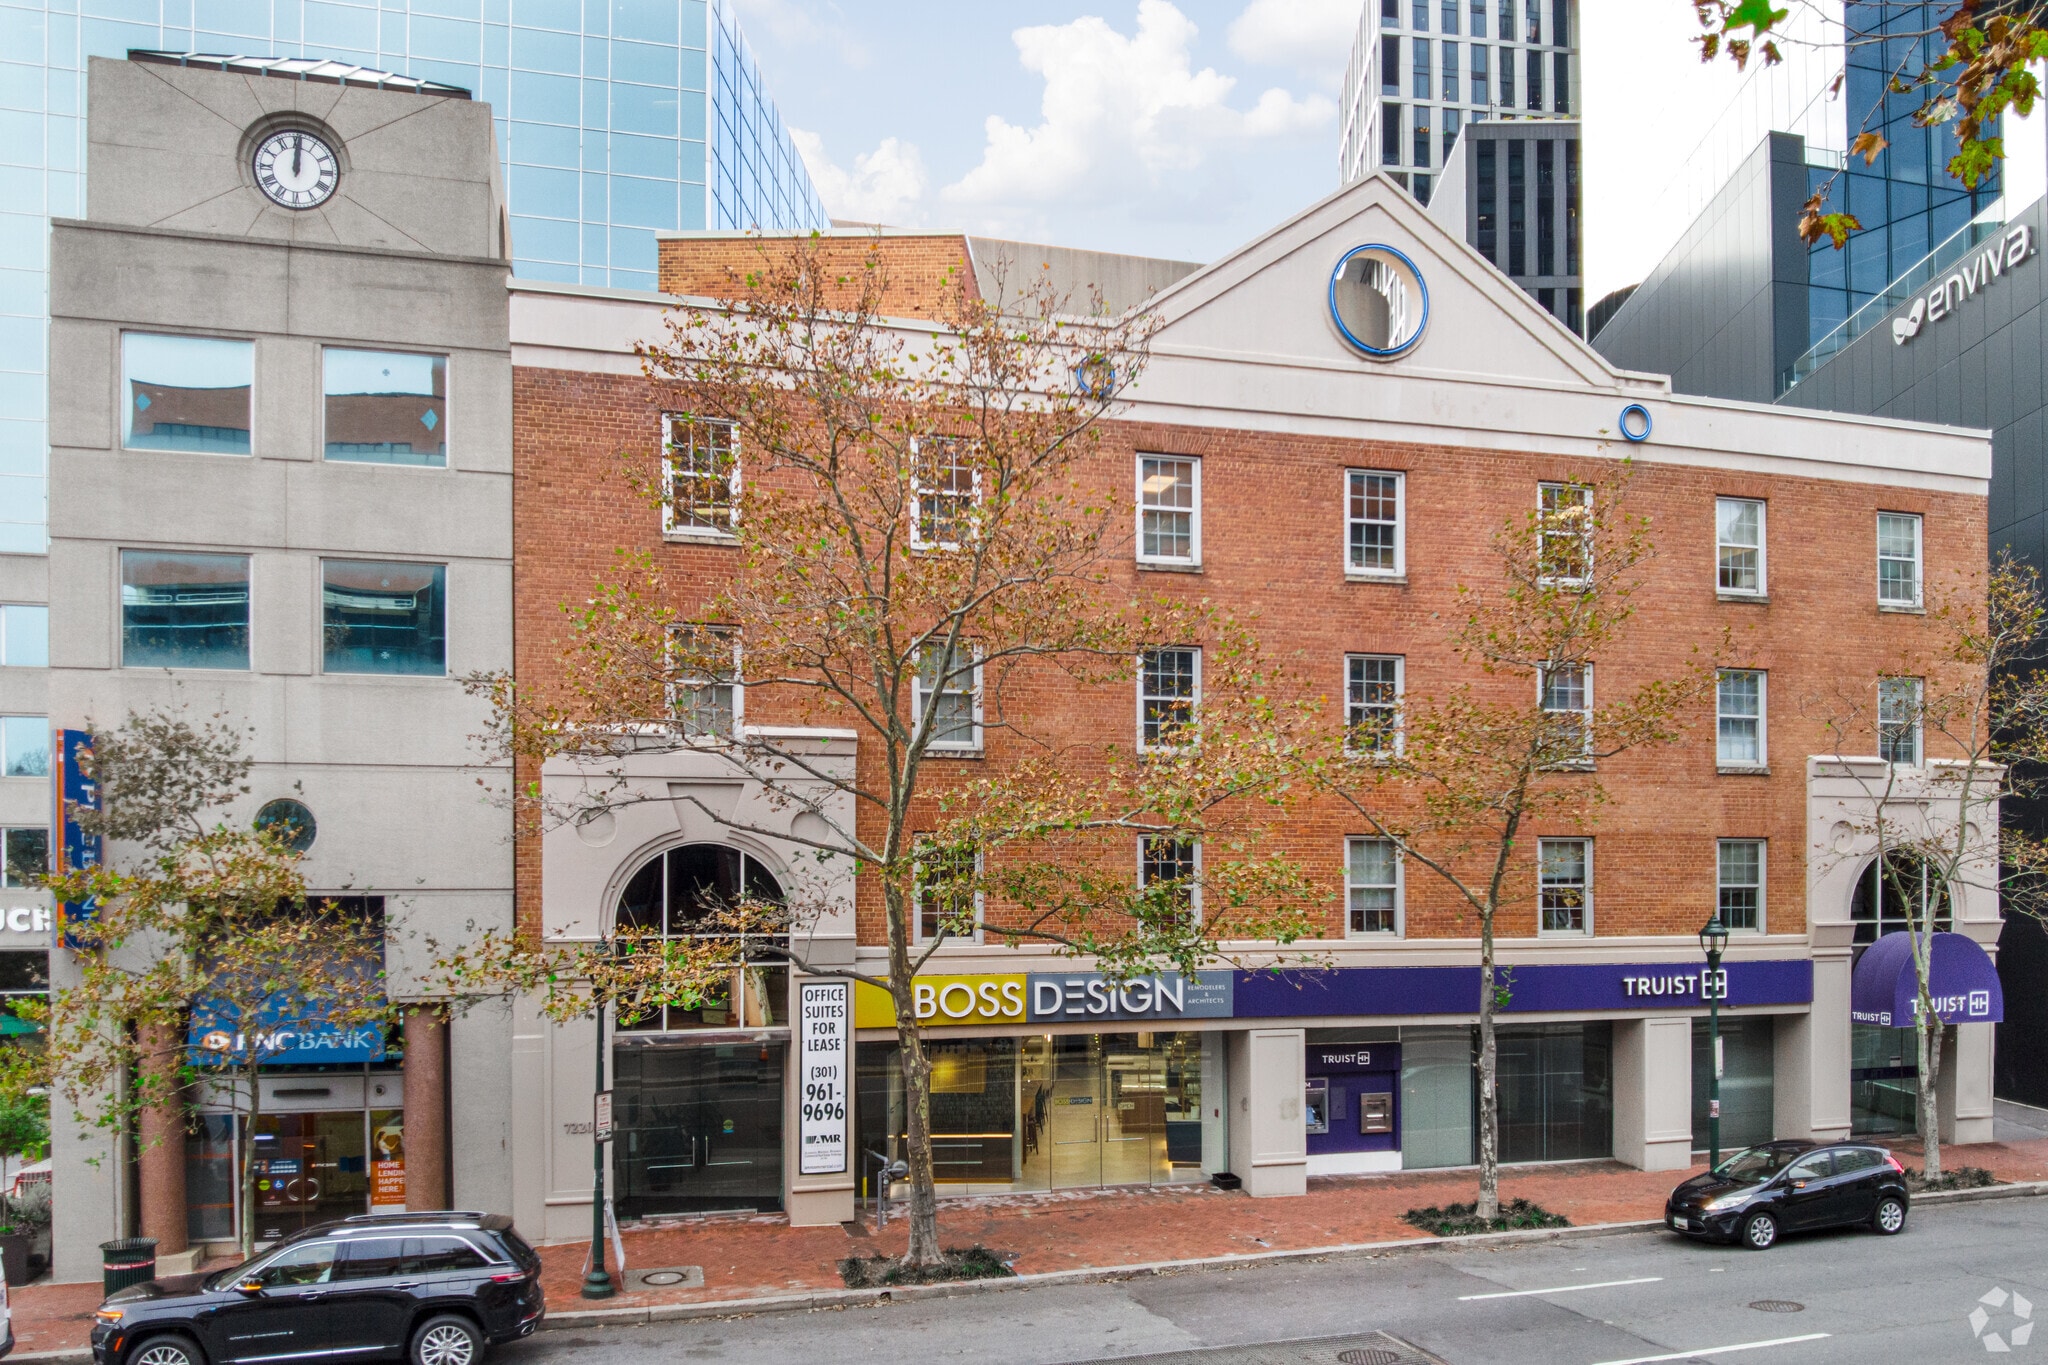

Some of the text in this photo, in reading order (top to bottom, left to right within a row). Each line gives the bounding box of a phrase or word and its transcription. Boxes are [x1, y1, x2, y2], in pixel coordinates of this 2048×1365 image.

[0, 908, 51, 932] CK
[1623, 976, 1697, 996] TRUIST
[805, 989, 844, 1002] OFFICE
[915, 978, 1183, 1018] BOSS DESIGN
[805, 1005, 844, 1018] SUITES
[1911, 996, 1966, 1014] TUIST
[1852, 1011, 1880, 1021] TRUIST
[812, 1022, 836, 1035] FOR
[808, 1038, 840, 1051] LEASE
[1322, 1055, 1356, 1063] TRUIST
[811, 1065, 837, 1081] (301)
[806, 1083, 841, 1101] 961-
[803, 1102, 844, 1121] 9696
[378, 1161, 400, 1169] HOME
